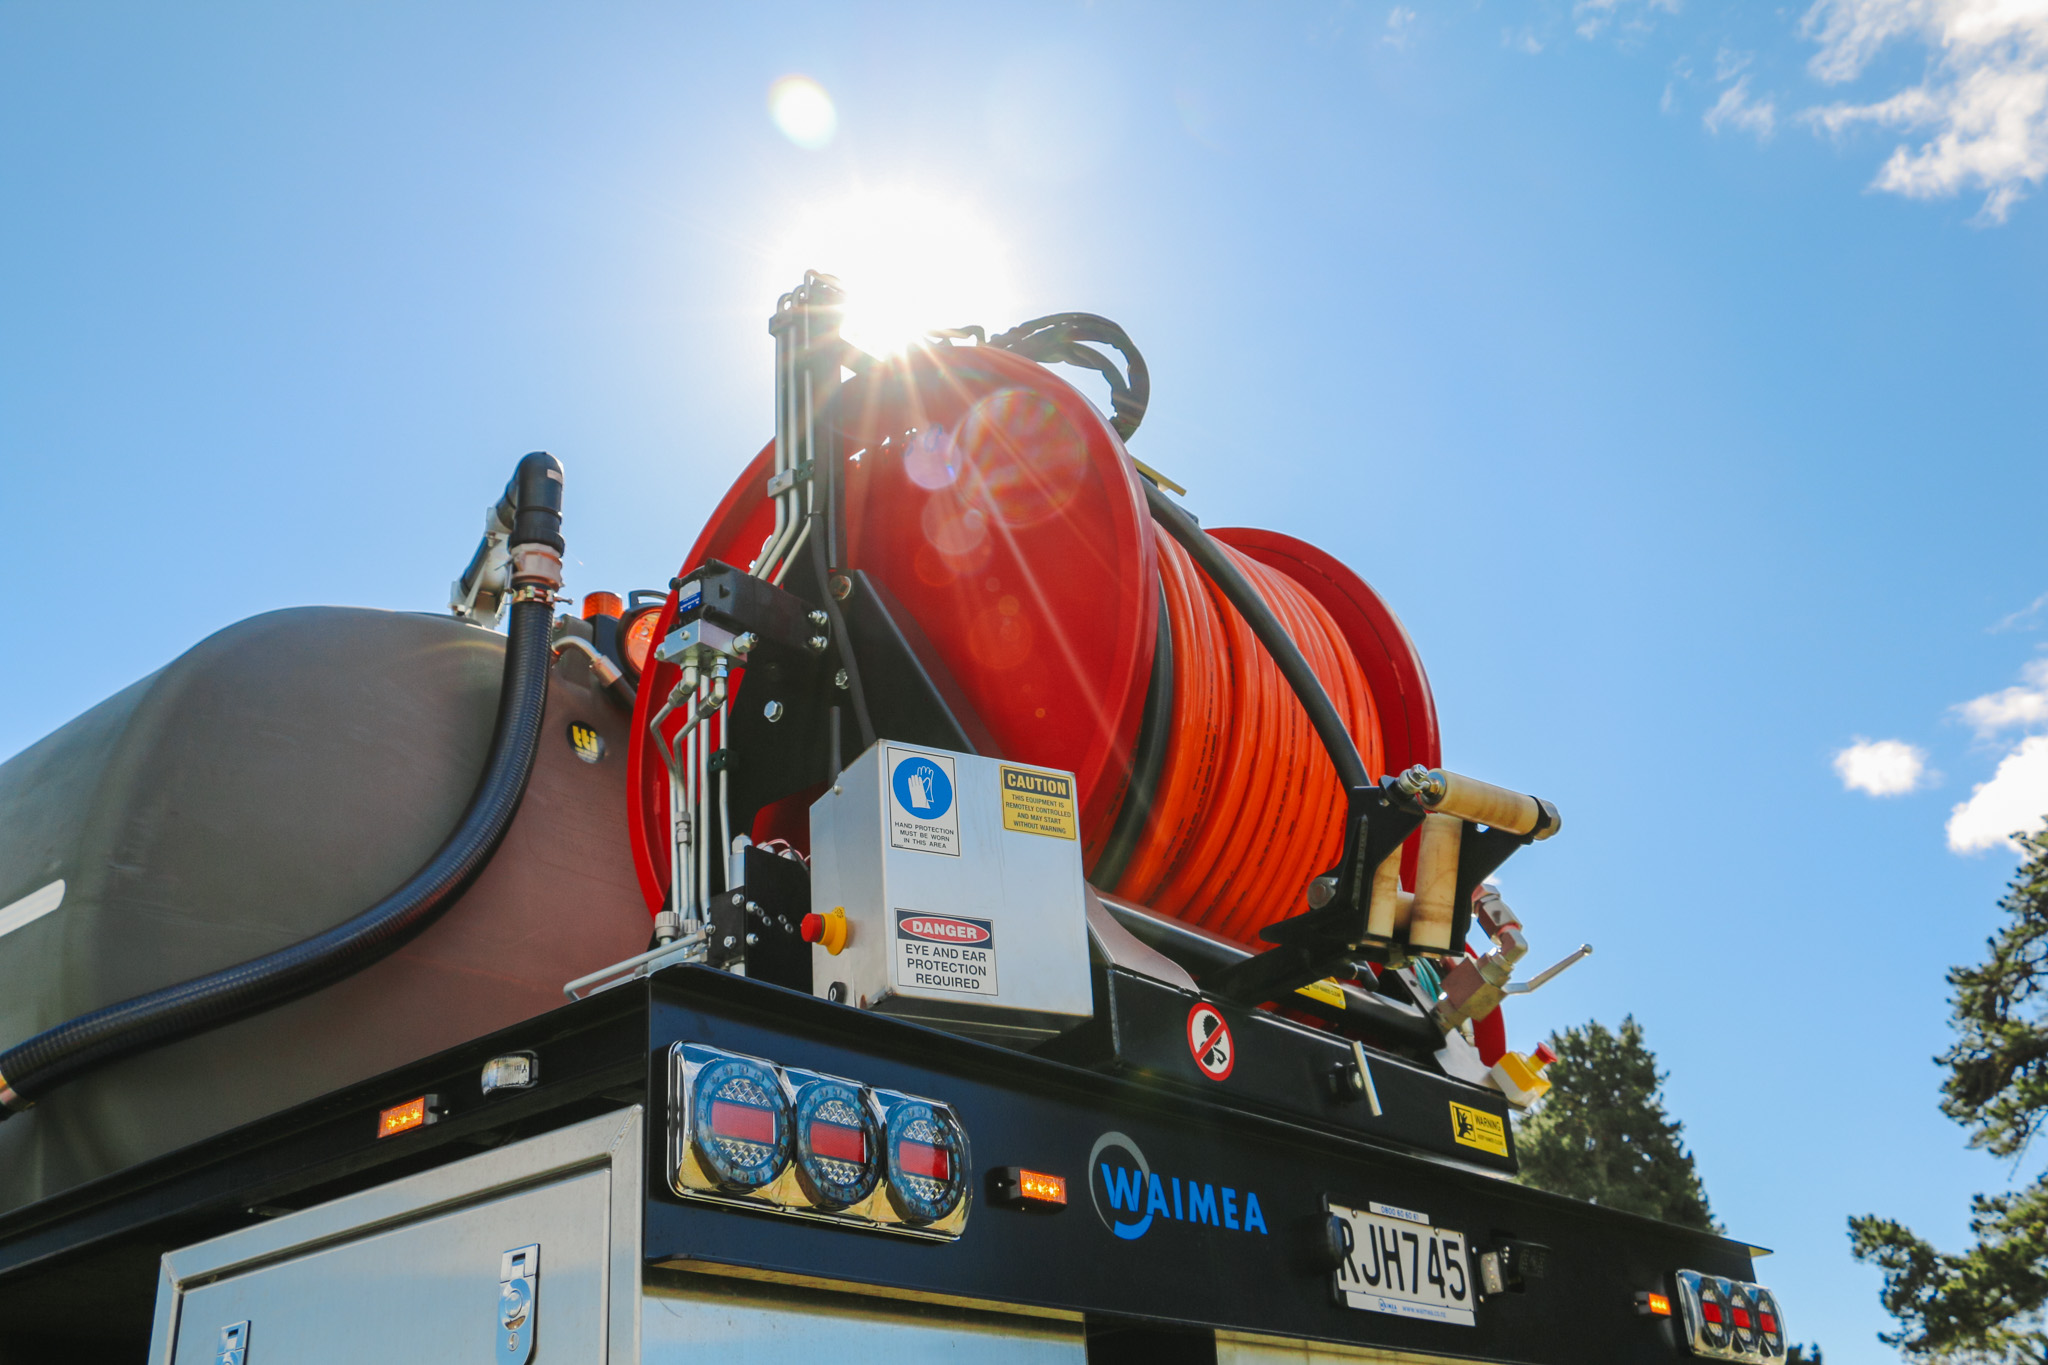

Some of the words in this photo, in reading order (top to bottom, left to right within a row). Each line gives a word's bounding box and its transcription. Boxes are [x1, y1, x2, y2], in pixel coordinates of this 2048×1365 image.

[1007, 773, 1067, 795] CAUTION
[1012, 793, 1025, 802] THIS
[1026, 796, 1057, 807] EQUIPMENT
[1005, 801, 1035, 812] REMOTELY
[1035, 806, 1072, 818] CONTROLLED
[1017, 812, 1030, 820] AND
[1030, 814, 1043, 822] MAY
[1043, 816, 1062, 825] START
[894, 821, 913, 830] HAND
[914, 824, 955, 836] PROTECTION
[900, 829, 917, 838] MUST
[930, 834, 950, 842] WORN
[1013, 820, 1039, 830] WITHOUT
[1039, 824, 1067, 835] WARNING
[912, 838, 927, 846] THIS
[929, 841, 947, 849] AREA
[912, 920, 978, 940] DANGER
[905, 943, 929, 956] EYE
[932, 946, 959, 959] AND
[962, 949, 987, 962] EAR
[907, 957, 987, 977] PROTECTION
[915, 973, 980, 990] REQUIRED
[1475, 1114, 1501, 1132] WARNING
[1100, 1162, 1269, 1236] WAIMEA
[1339, 1217, 1467, 1301] RJH745
